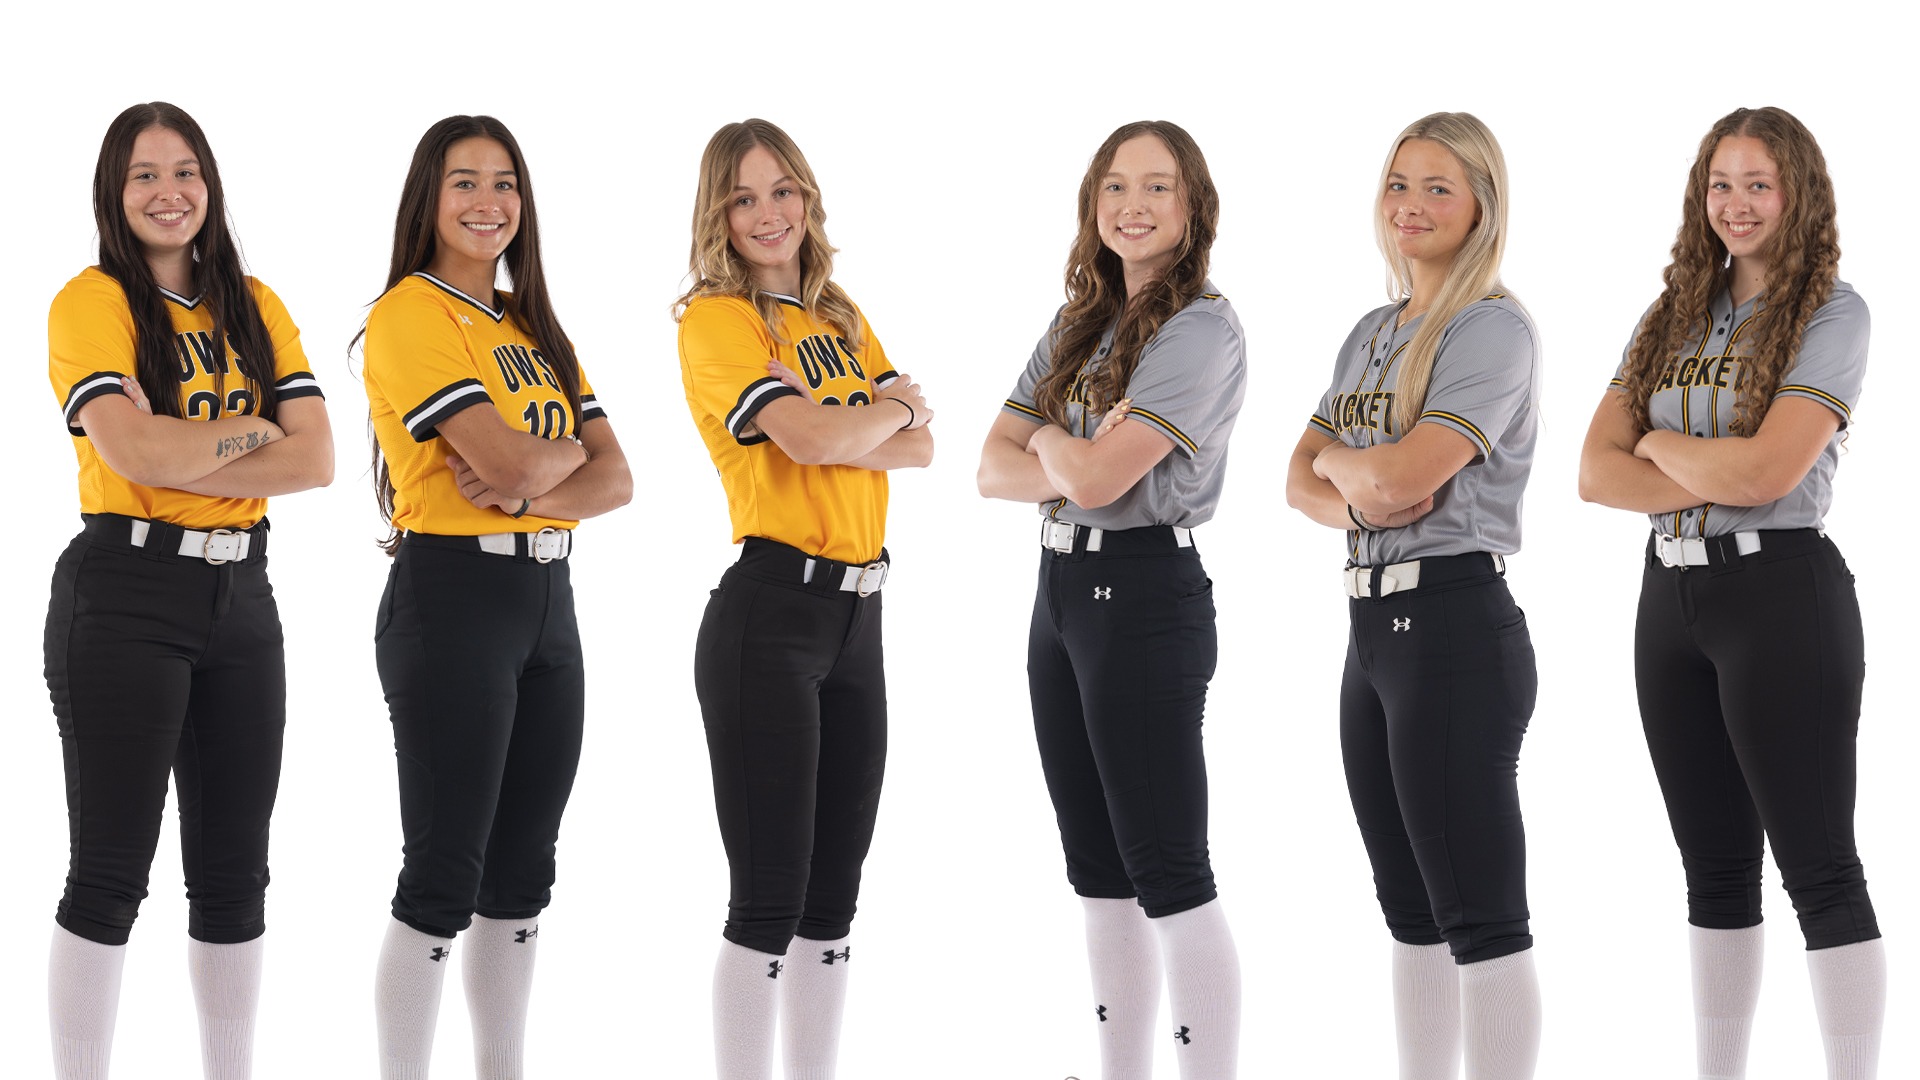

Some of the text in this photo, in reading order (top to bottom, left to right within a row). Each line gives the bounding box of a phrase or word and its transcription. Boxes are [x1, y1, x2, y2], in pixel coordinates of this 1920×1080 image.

[492, 343, 562, 395] UWS
[795, 333, 867, 391] UWS
[521, 399, 567, 441] 10
[1331, 391, 1396, 438] ACKET
